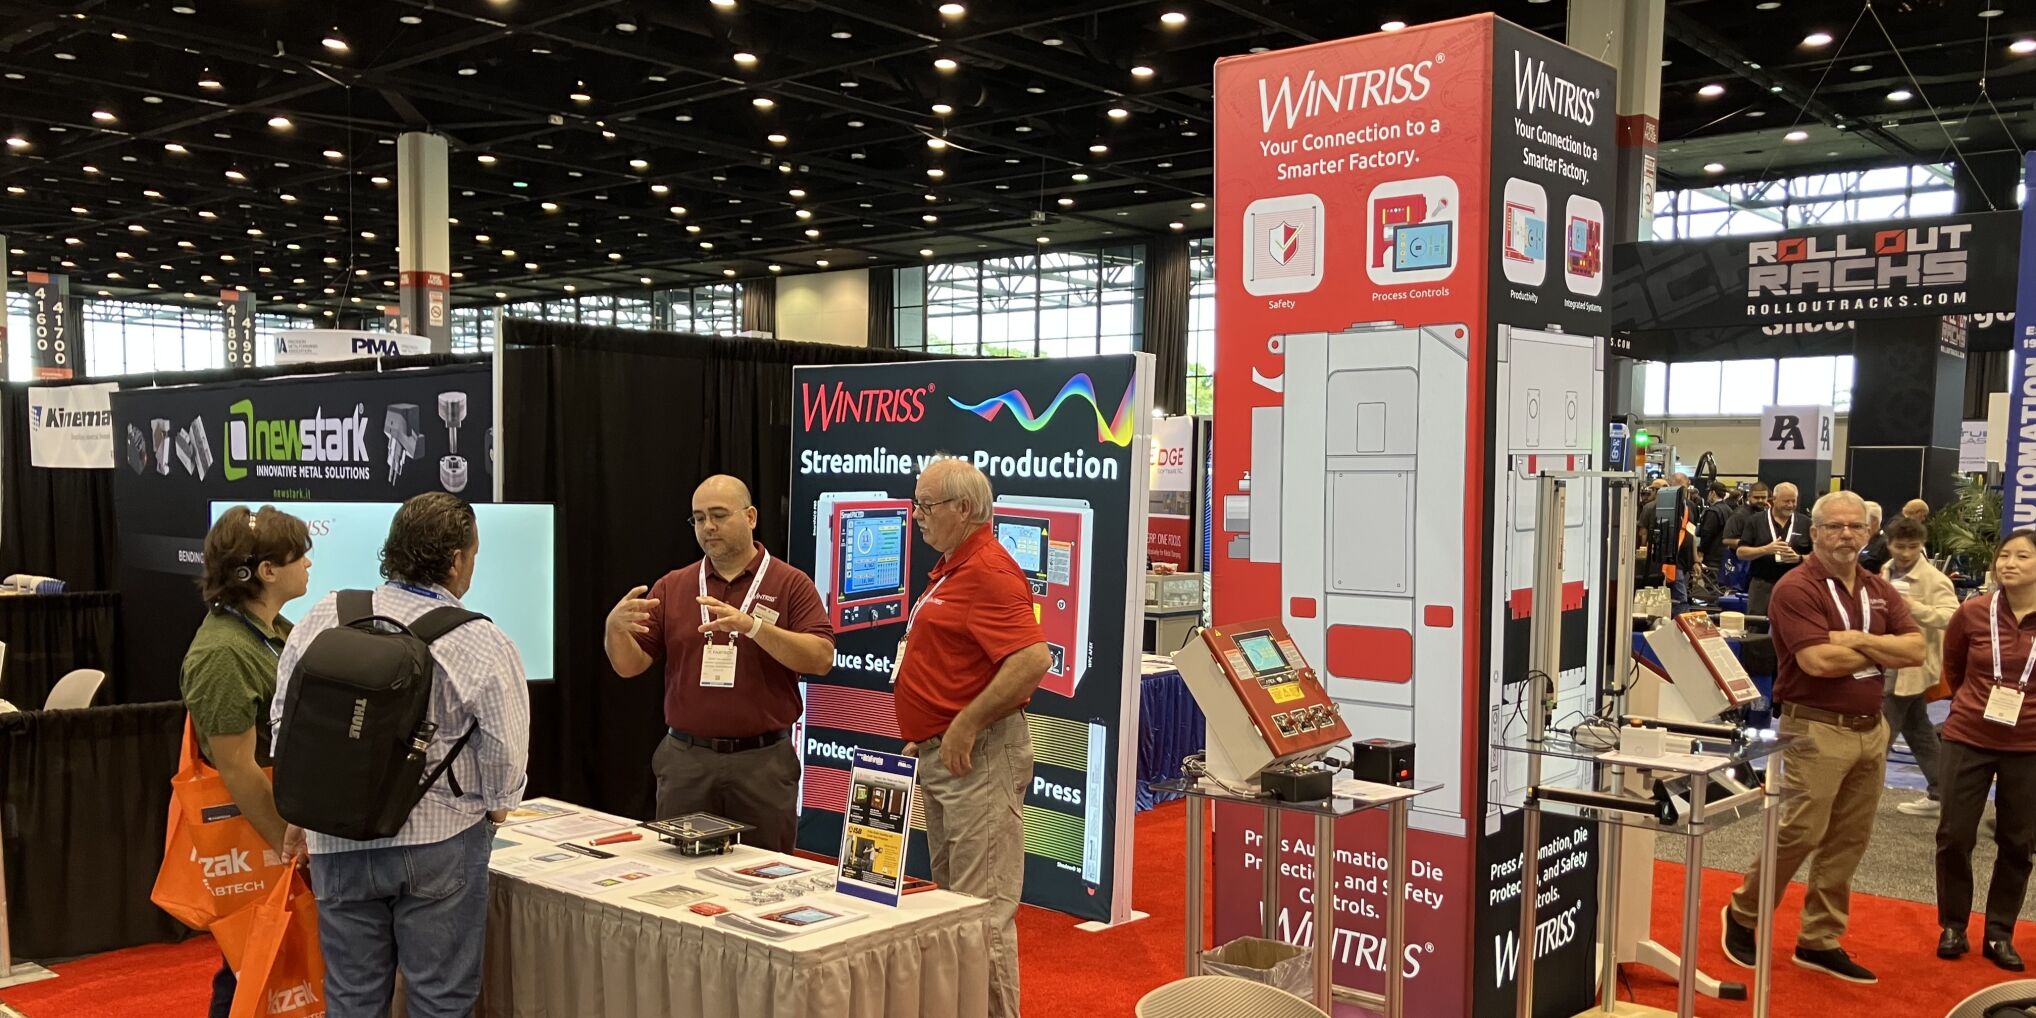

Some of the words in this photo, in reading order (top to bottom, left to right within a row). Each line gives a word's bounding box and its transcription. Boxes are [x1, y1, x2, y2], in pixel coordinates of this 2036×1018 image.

[1260, 139, 1298, 157] Your
[1302, 123, 1400, 151] Connection
[1406, 119, 1425, 137] to
[1430, 118, 1441, 133] a
[1514, 117, 1535, 140] Your
[1536, 125, 1582, 156] Connection
[1583, 141, 1592, 159] to
[1592, 148, 1598, 160] a
[1277, 158, 1345, 181] Smarter
[1350, 150, 1420, 171] Factory.
[1523, 147, 1557, 173] Smarter
[1558, 158, 1589, 186] Factory.
[1749, 234, 1866, 265] ROLL
[1875, 224, 1972, 254] OUT
[1748, 250, 1968, 298] RACKS
[1268, 299, 1296, 310] Safety
[1372, 291, 1407, 302] Process
[1410, 288, 1450, 299] Controls
[1510, 289, 1538, 304] Productivity
[1564, 298, 1586, 310] Integrated
[1586, 302, 1602, 312] Systems
[1747, 291, 1967, 316] ROLLOUTRACKS.COM
[34, 287, 48, 351] 41600
[52, 302, 66, 364] 41700
[226, 304, 238, 363] 41800
[242, 318, 252, 368] 4190
[352, 338, 400, 356] PMA
[256, 464, 297, 478] INNOVATIVE
[299, 466, 323, 479] METAL
[325, 466, 370, 480] SOLUTIONS
[800, 446, 913, 475] Streamline
[974, 448, 1119, 480] Production
[348, 698, 368, 740] THULE
[807, 738, 859, 761] Protec
[1034, 776, 1082, 805] Press
[191, 847, 252, 878] zak
[1244, 830, 1288, 852] Prs
[1411, 859, 1444, 882] Die
[1490, 858, 1516, 880] Press
[1518, 836, 1572, 869] Amation,
[1574, 826, 1588, 844] Die
[1543, 860, 1560, 882] and
[1560, 850, 1588, 874] Safety
[203, 880, 264, 896] BTECH
[1344, 875, 1377, 894] and
